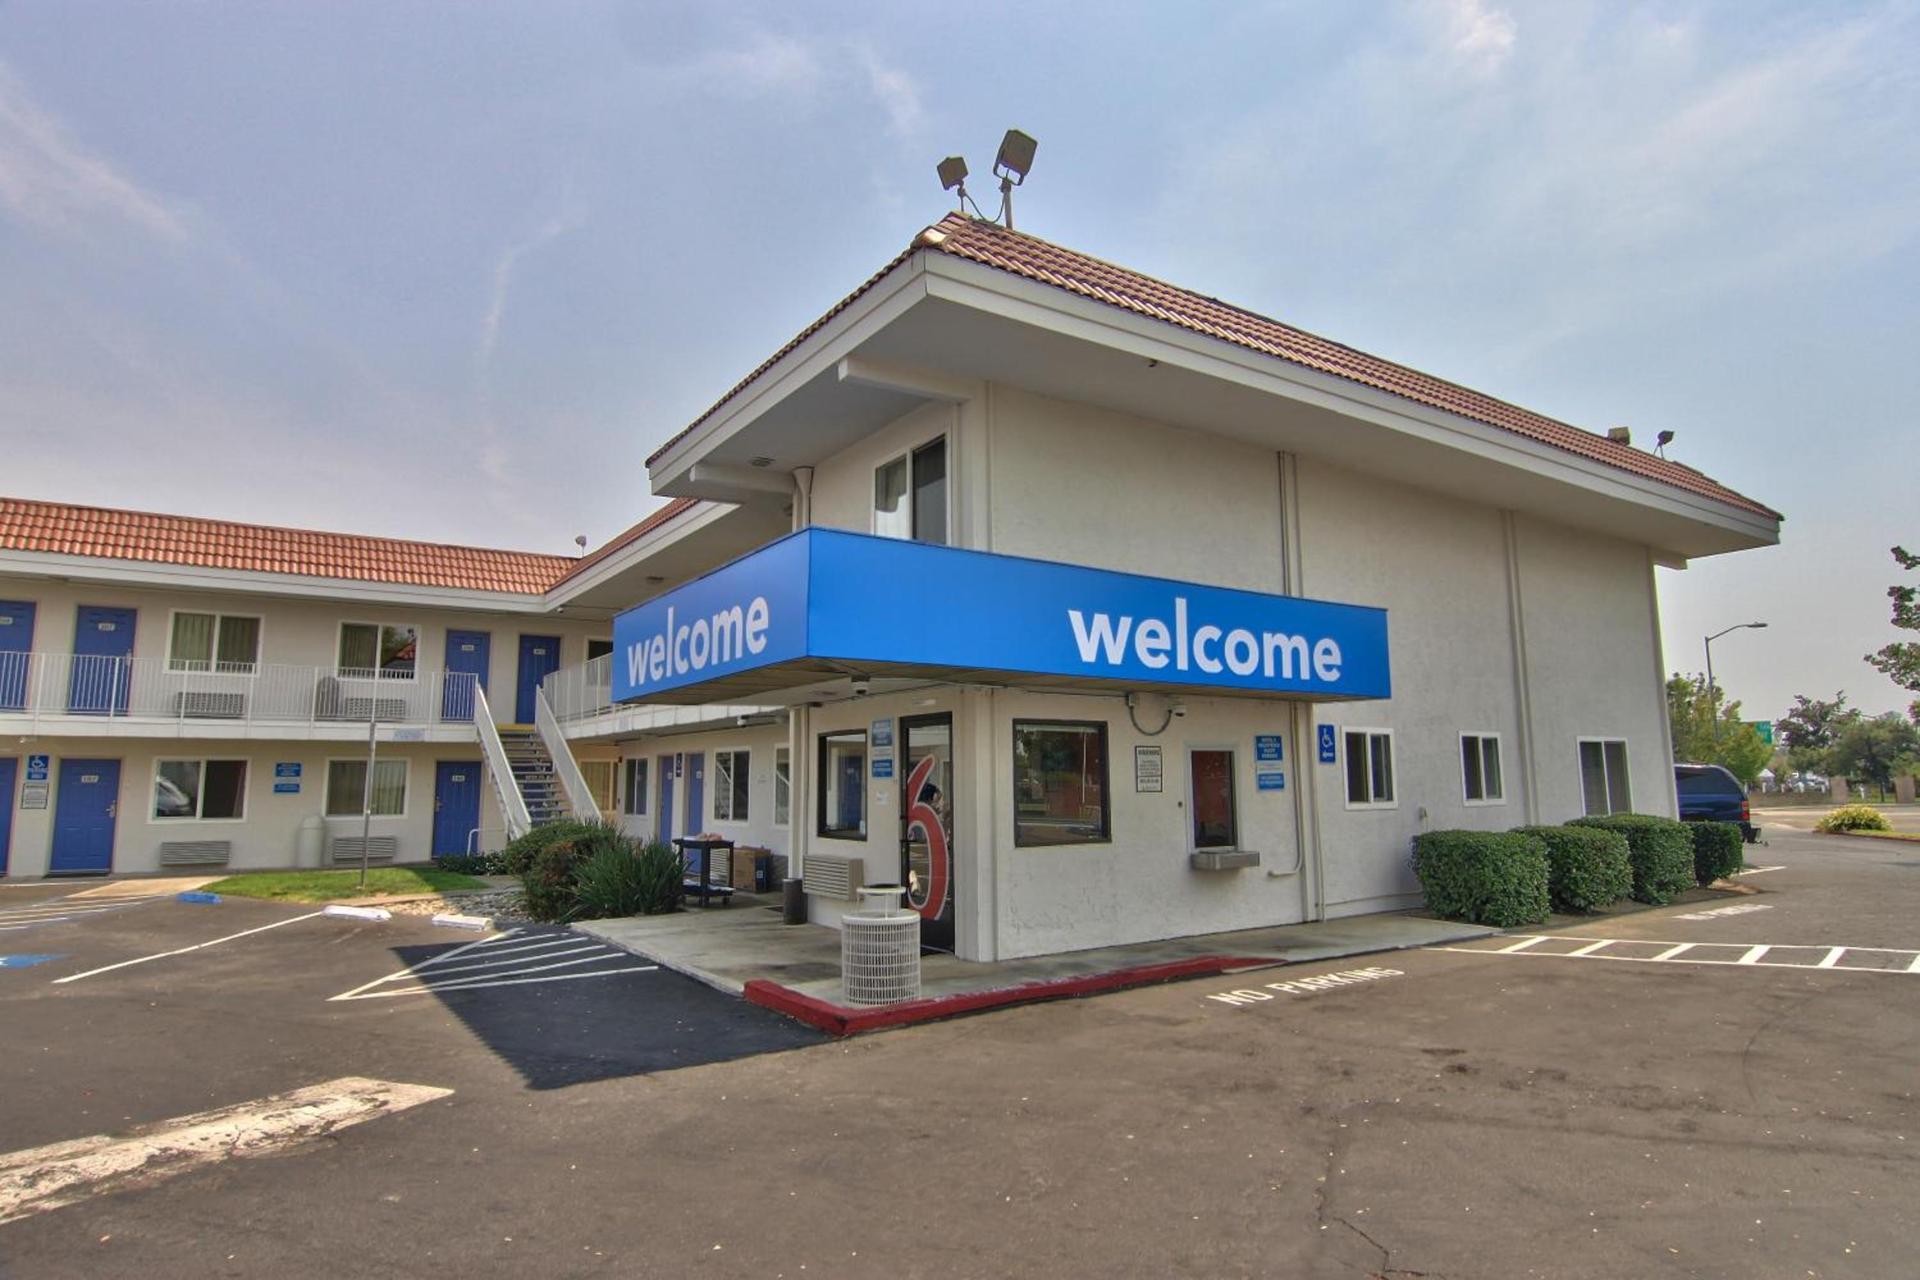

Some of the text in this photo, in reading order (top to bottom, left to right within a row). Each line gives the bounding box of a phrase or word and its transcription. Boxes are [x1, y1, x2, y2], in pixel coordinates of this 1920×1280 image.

[627, 596, 770, 688] welcome
[1067, 597, 1343, 682] welcome
[1205, 966, 1405, 1006] NO PARKING
